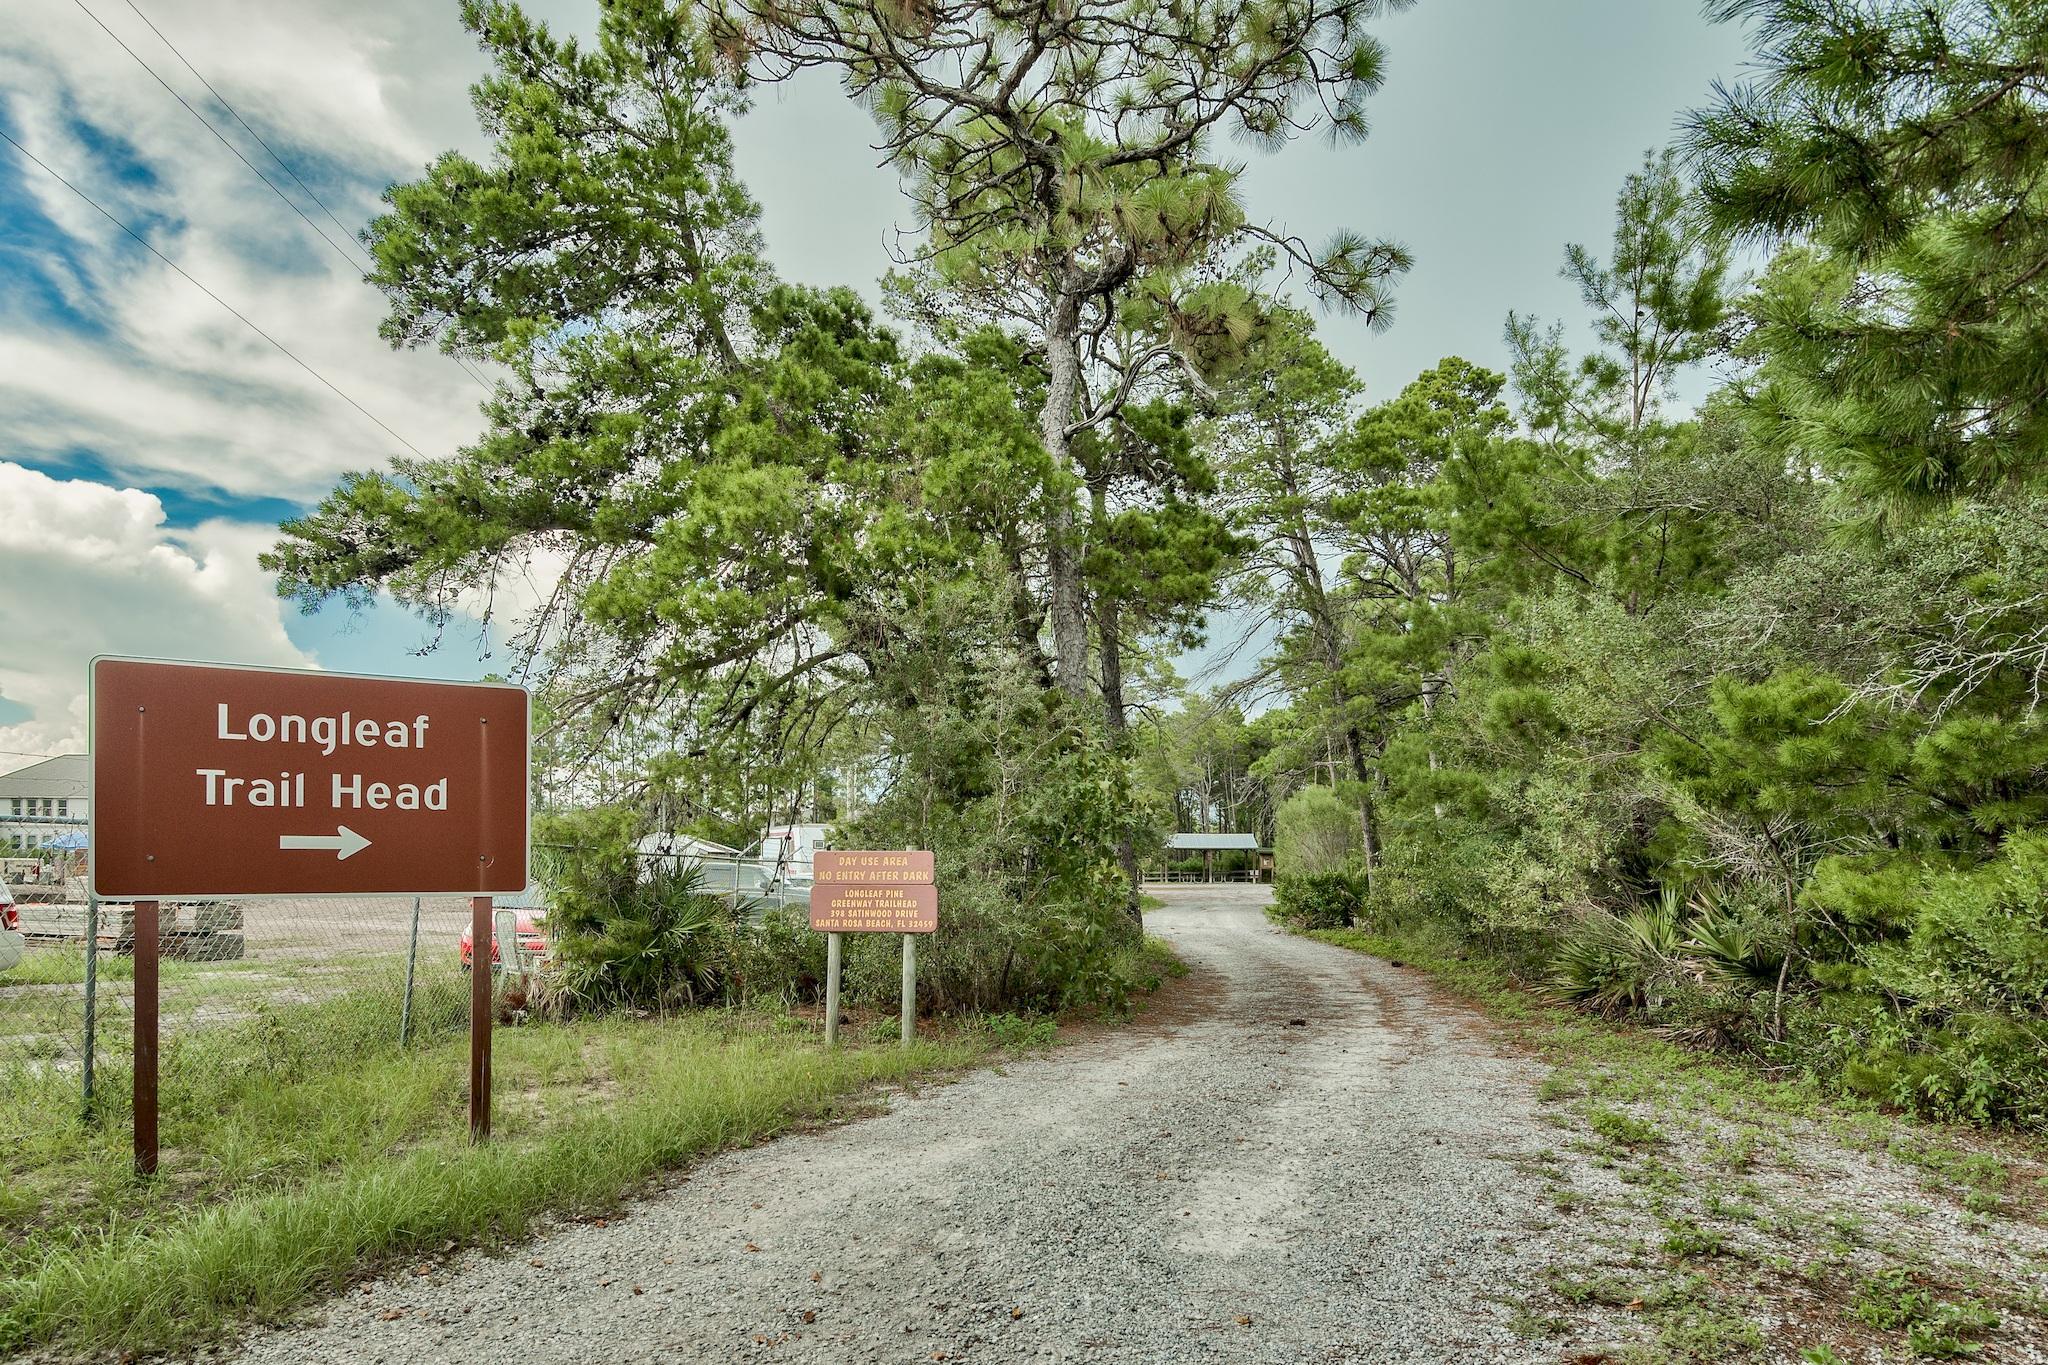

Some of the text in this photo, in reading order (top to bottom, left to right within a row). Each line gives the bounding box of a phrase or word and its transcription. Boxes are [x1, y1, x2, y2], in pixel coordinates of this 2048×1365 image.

[218, 704, 429, 756] Longleaf
[196, 769, 448, 811] Trail Head
[840, 857, 908, 866] DAY USE AREA
[819, 871, 928, 881] NO ENTRY AFTER DARK
[845, 890, 883, 898] LONGLEAF
[831, 900, 917, 908] GREENWAY TRAILHEAD
[830, 910, 918, 918] 398 SATINWOOD DRIVE
[816, 920, 839, 928] SANTA
[866, 920, 893, 928] BEACH,
